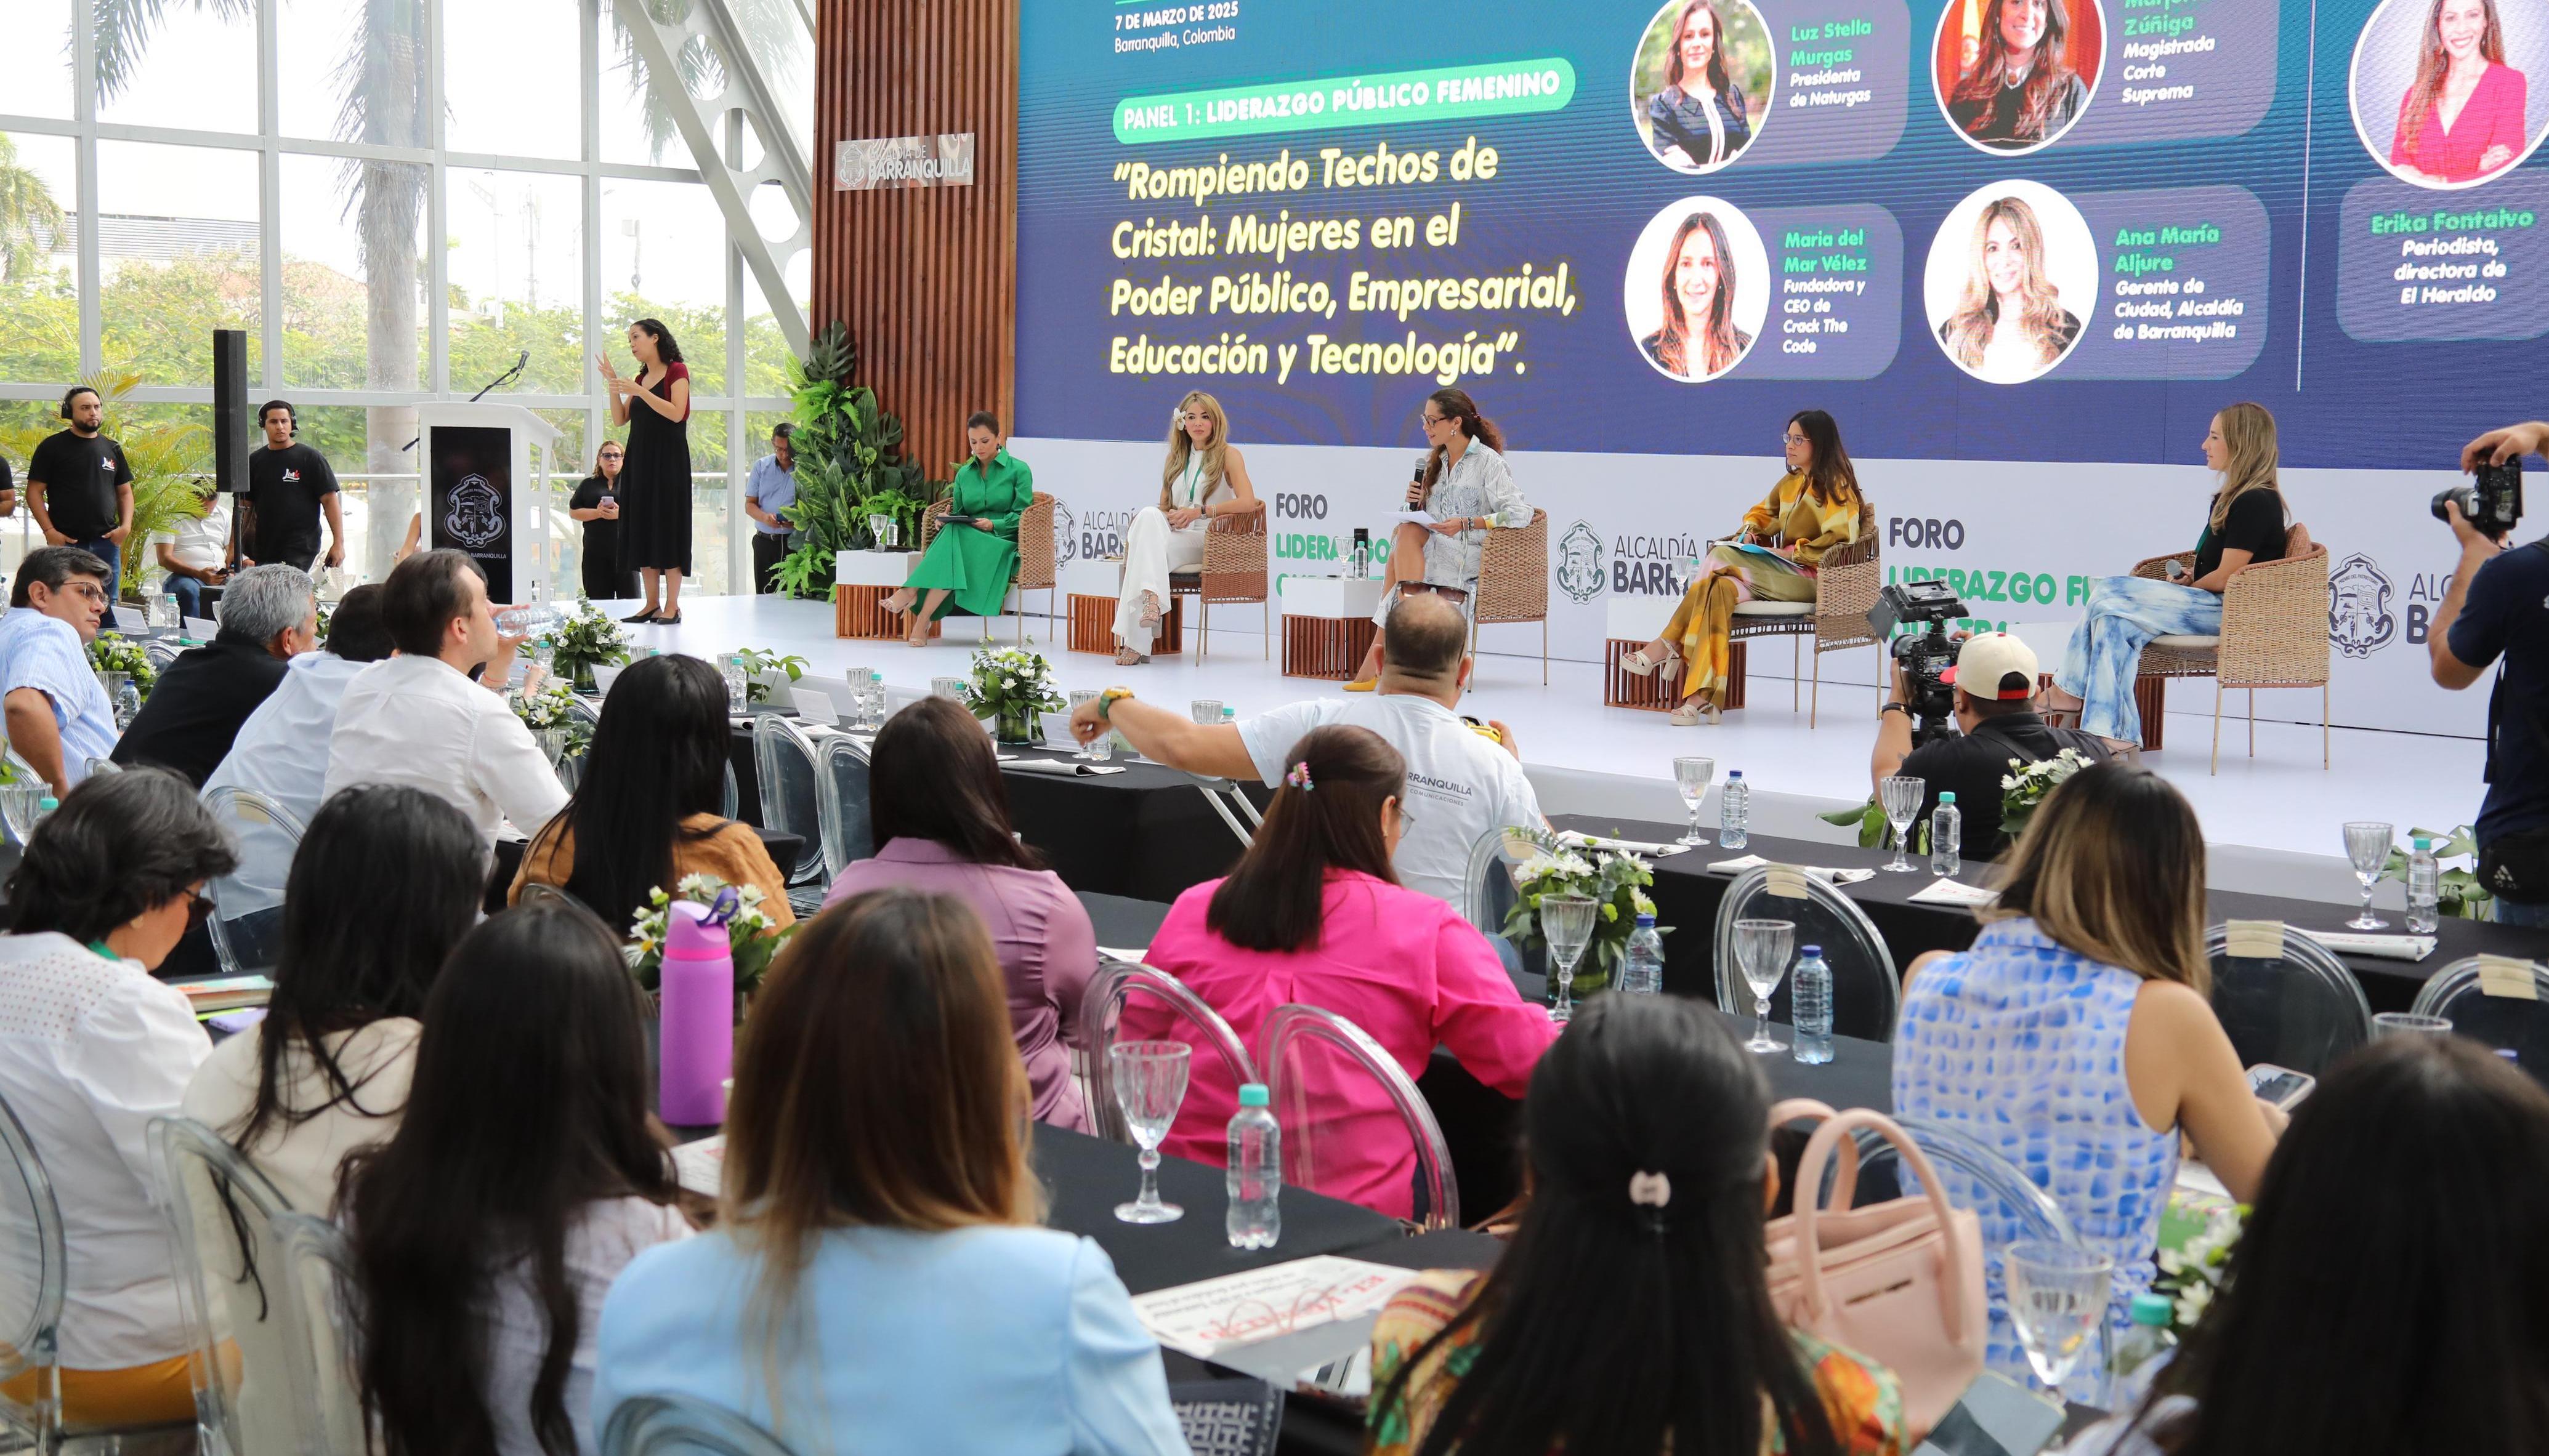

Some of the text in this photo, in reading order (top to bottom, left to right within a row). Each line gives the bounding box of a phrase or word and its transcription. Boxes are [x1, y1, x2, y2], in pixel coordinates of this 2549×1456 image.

[1115, 1, 1239, 31] 7 DE MARZO DE 2025
[2124, 14, 2194, 37] Zúñiga
[1115, 25, 1235, 53] Barranquilla, Colombia
[1792, 18, 1872, 42] Luz Stella
[1790, 47, 1852, 68] Murgas
[2123, 36, 2215, 60] Magistrada
[1790, 69, 1860, 87] Presidenta
[2123, 63, 2166, 81] Corte
[1123, 70, 1561, 131] PANEL 1: LIDERAZGO PÚBLICO FEMENINO
[1790, 89, 1872, 108] de Naturgas
[2122, 83, 2194, 106] Suprema
[915, 144, 927, 159] DE
[1320, 140, 1440, 189] Techos
[1449, 135, 1499, 181] de
[868, 156, 971, 181] BARRANQUILLA
[1112, 201, 1461, 263] Cristal: Mujeres en el
[2371, 208, 2535, 235] Erika Fontalvo
[1785, 228, 1864, 248] Maria del
[2115, 223, 2220, 246] Ana María
[2402, 236, 2499, 257] Periodista,
[1784, 254, 1867, 273] Mar Vélez
[2115, 254, 2173, 277] Aljure
[2394, 260, 2507, 281] directora de
[1110, 262, 1577, 322] Poder Público, Empresarial,
[1783, 278, 1866, 297] Fundadora y
[2115, 278, 2205, 297] Gerente de
[2401, 284, 2497, 305] El Heraldo
[1783, 297, 1831, 314] CEO de
[2115, 298, 2244, 320] Ciudad, Alcaldía
[1783, 318, 1848, 334] Crack The
[2114, 321, 2237, 343] de Barranquilla
[1110, 331, 1269, 375] Educación
[1277, 342, 1298, 385] y
[1782, 339, 1817, 354] Code
[1275, 493, 1328, 520] FORO
[1083, 508, 1135, 531] ALCALDÍ
[1889, 517, 1965, 550] FORO
[1614, 533, 1698, 560] ALCALDÍA
[1407, 771, 1472, 796] RRANQUILLA
[1410, 789, 1464, 806] COMUNICACIONES
